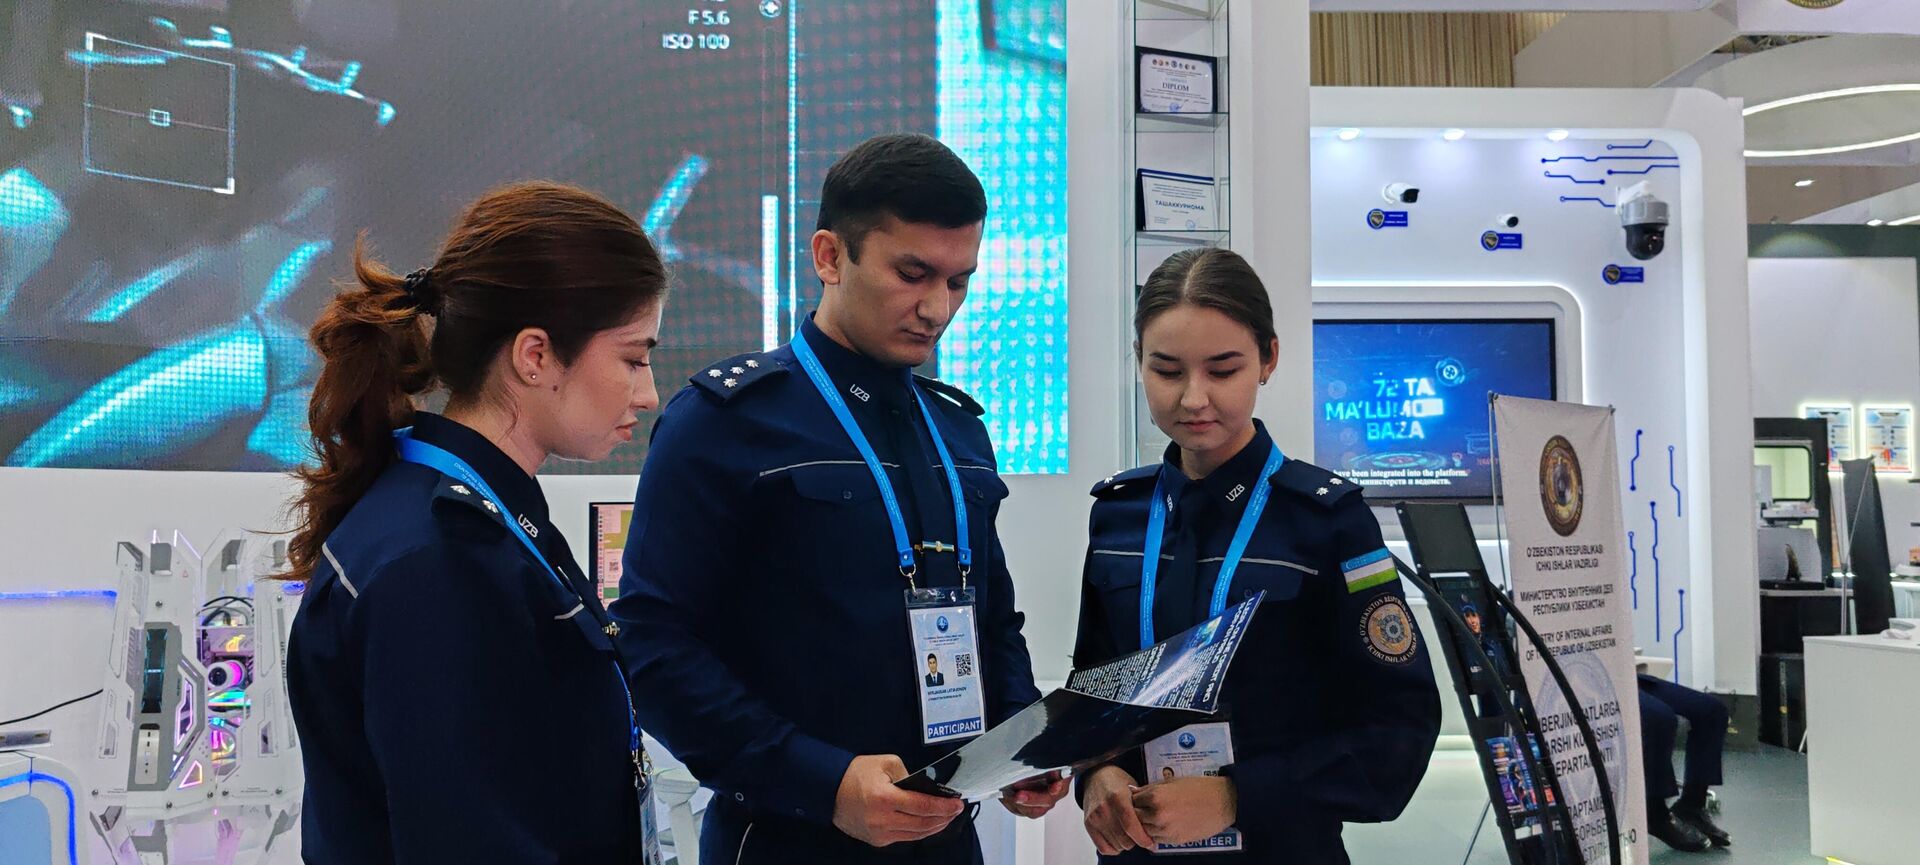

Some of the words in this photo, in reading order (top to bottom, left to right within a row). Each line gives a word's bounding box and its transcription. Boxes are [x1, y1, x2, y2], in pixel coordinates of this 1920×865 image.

[688, 10, 699, 25] F
[702, 10, 730, 25] 5.6
[662, 34, 693, 49] ISO
[698, 34, 730, 49] 100
[1162, 82, 1189, 92] DIPLOM
[850, 384, 870, 402] UZB
[1403, 377, 1436, 397] TA
[1366, 421, 1424, 441] BAZA
[1352, 469, 1369, 477] been
[1370, 469, 1405, 479] integrated
[1407, 469, 1421, 477] into
[1422, 469, 1434, 477] the
[1225, 483, 1246, 502] UZB
[518, 513, 539, 538] UZB
[1552, 559, 1573, 570] ISHLAR
[1520, 588, 1567, 602] МИНИСТЕРСТВО
[1568, 586, 1602, 597] ВНУТРЕННИХ
[1533, 602, 1570, 615] РЕСПУБЛИКИ
[1556, 631, 1563, 641] OF
[1565, 627, 1591, 640] INTERNAL
[1592, 624, 1612, 636] AFFAIRS
[1526, 650, 1534, 661] OF
[1577, 642, 1584, 653] OF
[1585, 638, 1616, 651] UZBEKISTAN
[928, 720, 981, 738] PARTICIPANT
[1574, 723, 1619, 748] KUSHISH
[1555, 747, 1613, 777] EPARTANTI
